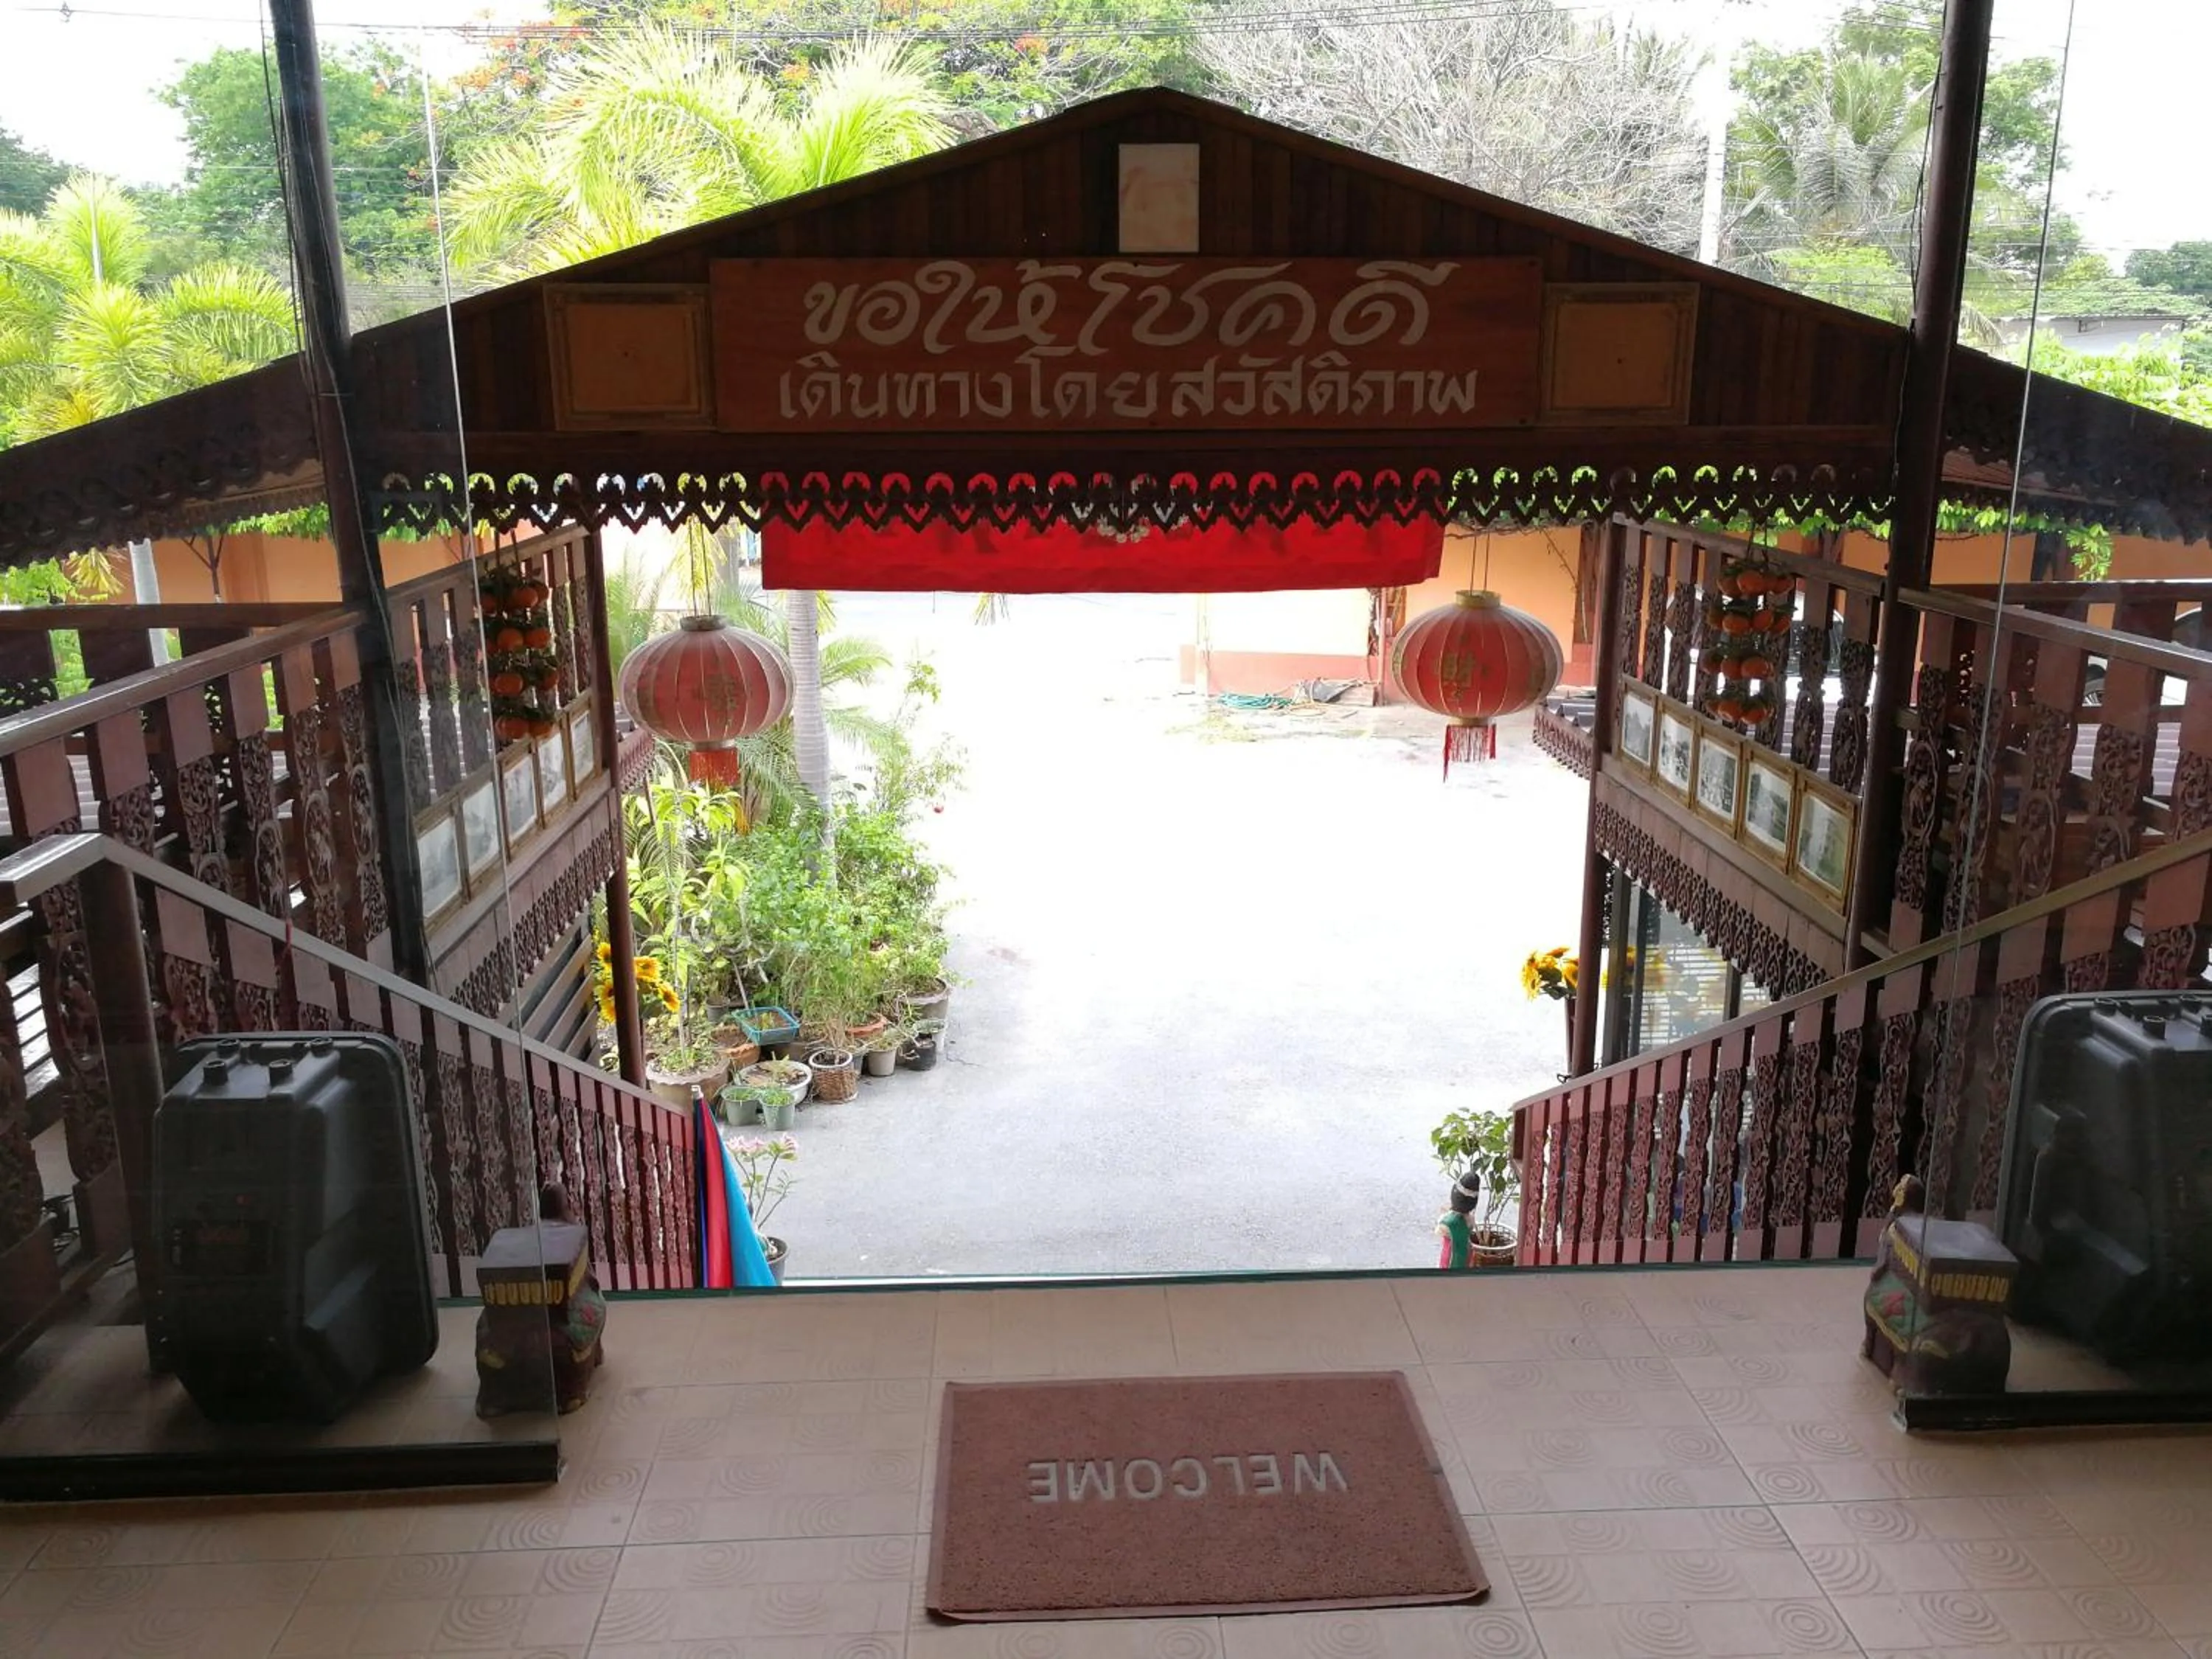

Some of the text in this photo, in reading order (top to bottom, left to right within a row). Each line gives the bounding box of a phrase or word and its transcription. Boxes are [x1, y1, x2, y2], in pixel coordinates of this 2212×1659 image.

[804, 260, 1461, 354] ขอให้โชคดี
[779, 346, 1478, 419] เดินทางโดยสวัสดิภาพ
[1028, 1453, 1348, 1502] WELCOME
